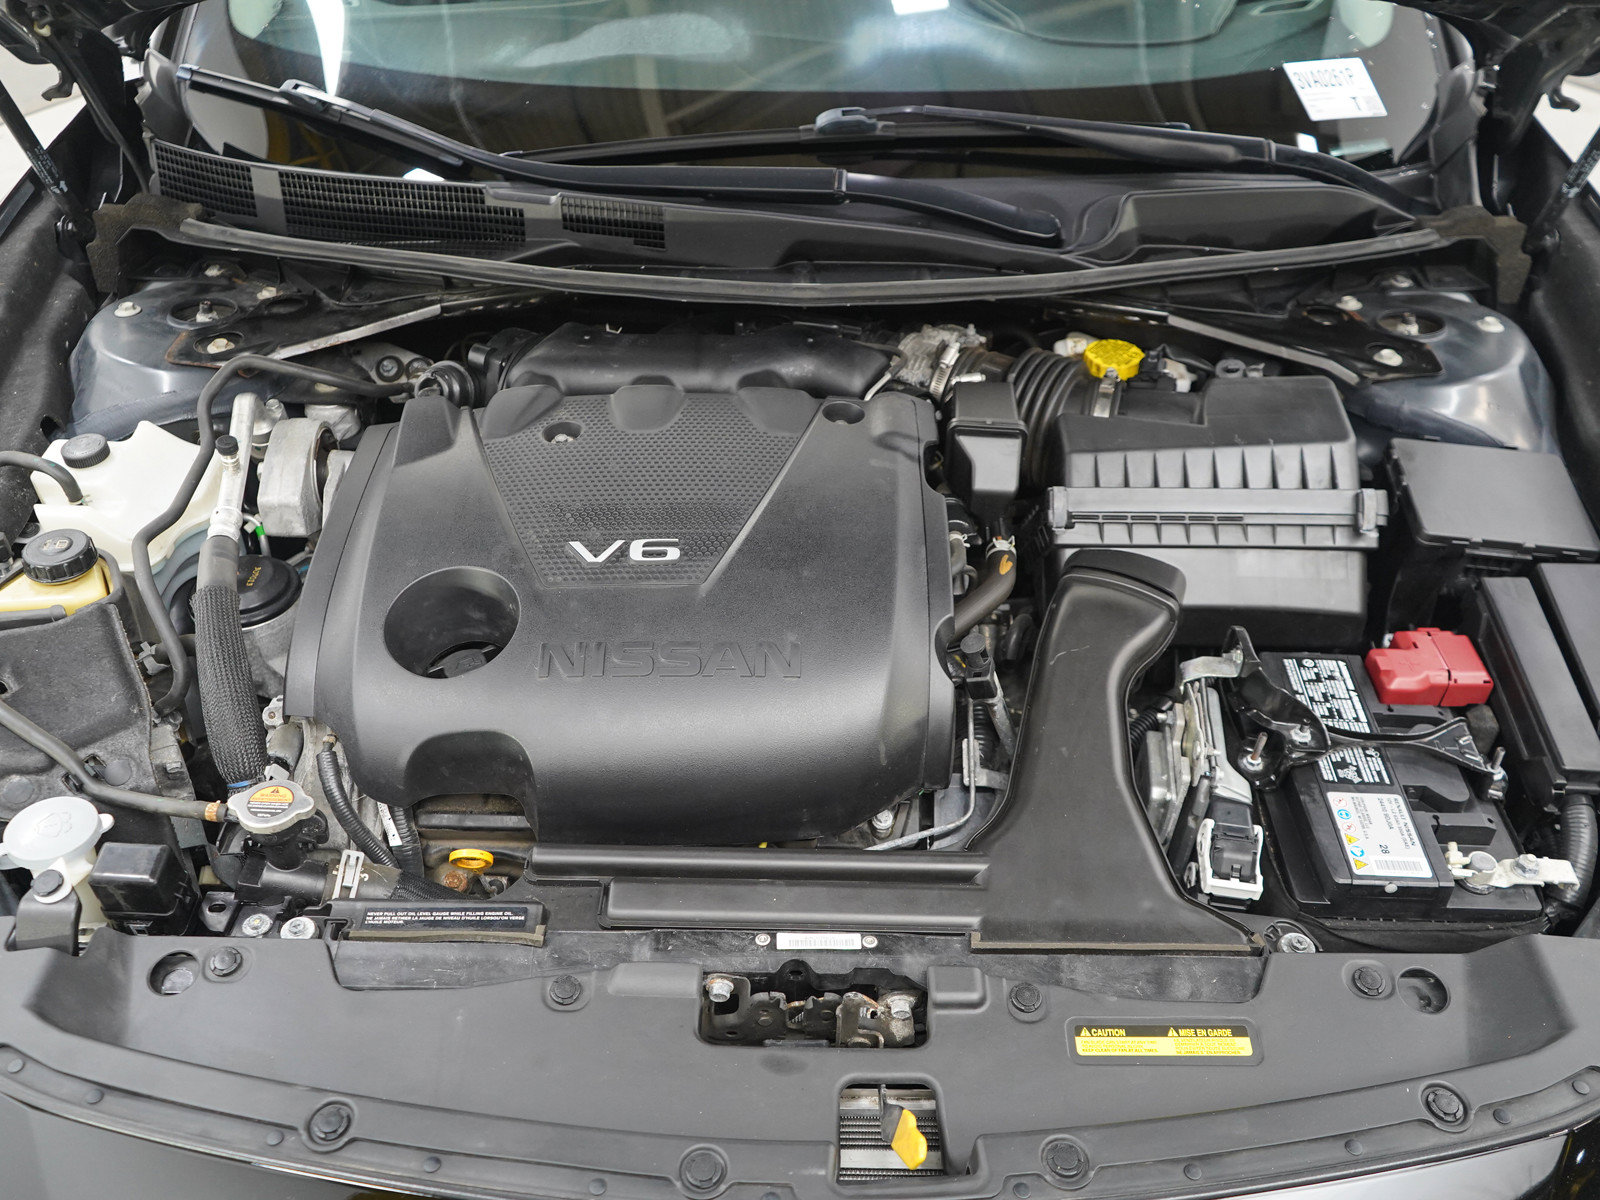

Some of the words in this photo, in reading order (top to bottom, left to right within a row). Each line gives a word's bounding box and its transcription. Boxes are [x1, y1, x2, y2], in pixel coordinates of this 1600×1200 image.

[568, 538, 681, 564] V6
[538, 641, 801, 678] NISSAN
[1379, 844, 1390, 854] 28
[1091, 1028, 1126, 1037] CAUTION
[1178, 1028, 1196, 1037] MISE
[1196, 1028, 1207, 1037] EN
[1207, 1028, 1232, 1037] GARDE
